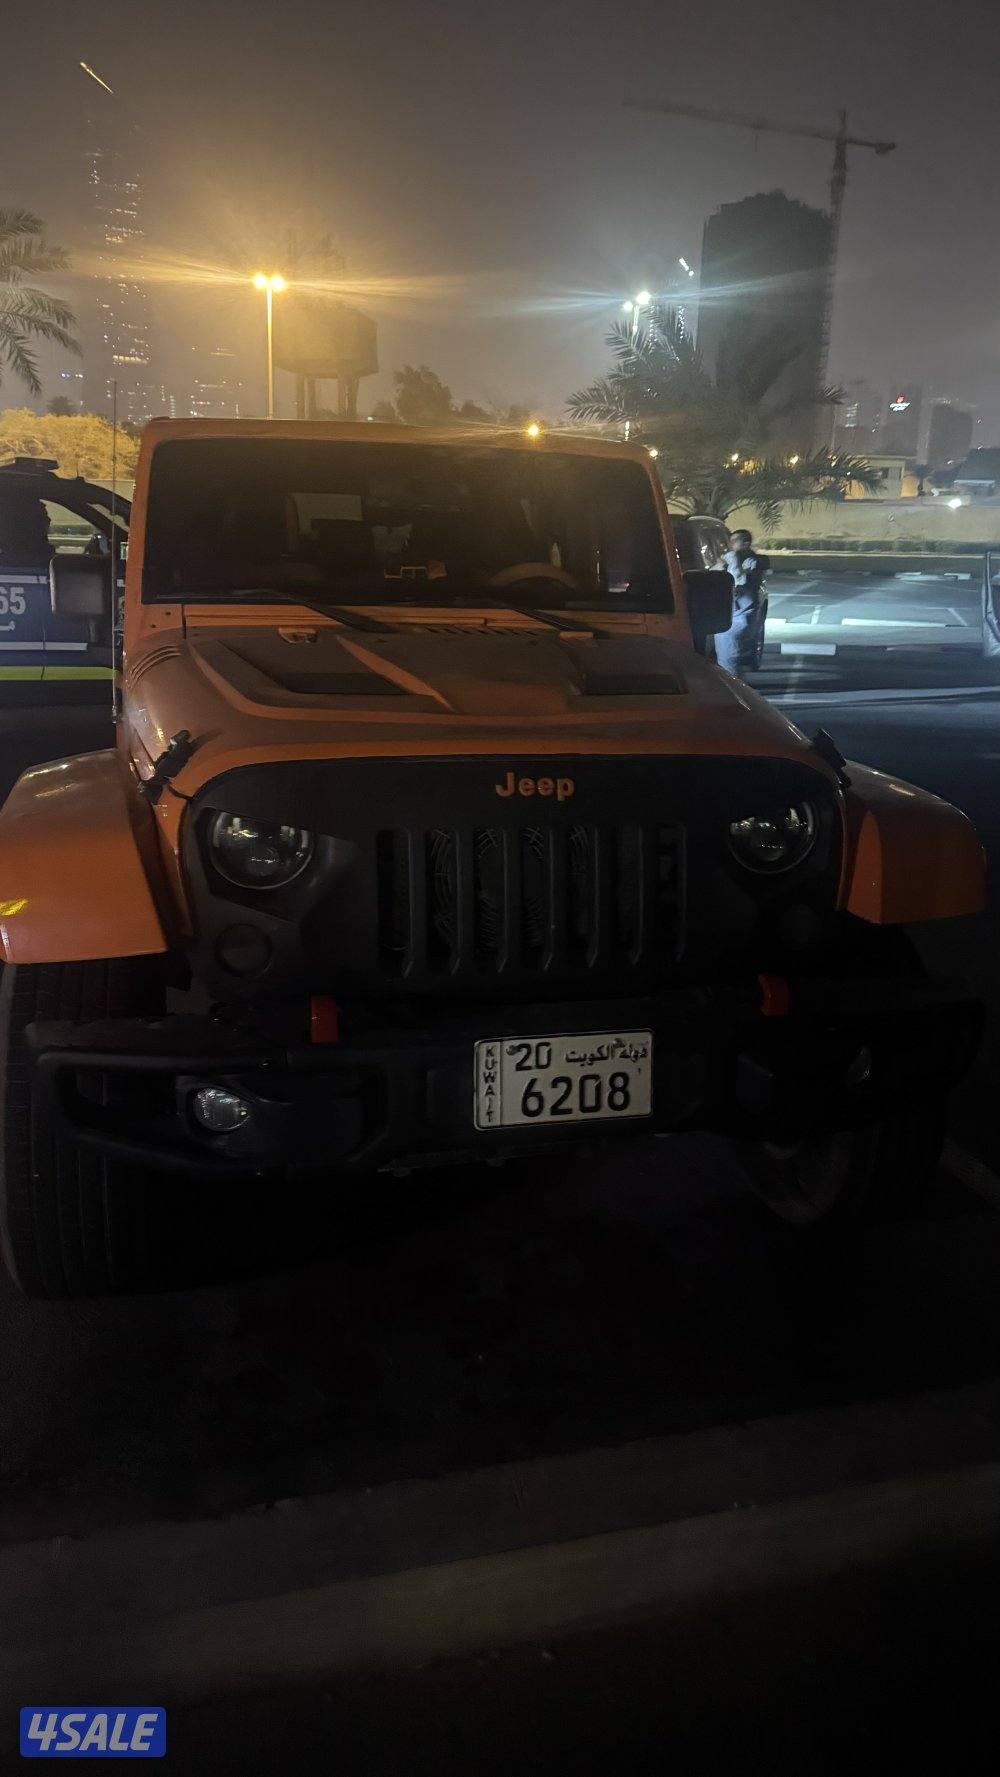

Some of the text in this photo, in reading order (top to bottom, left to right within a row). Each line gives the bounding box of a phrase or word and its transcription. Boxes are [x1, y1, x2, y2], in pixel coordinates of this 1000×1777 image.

[495, 770, 576, 801] Jeep
[515, 1042, 552, 1071] 20
[565, 1044, 614, 1067] الكويت
[483, 1045, 497, 1122] KUWAIT
[521, 1072, 629, 1117] 6208
